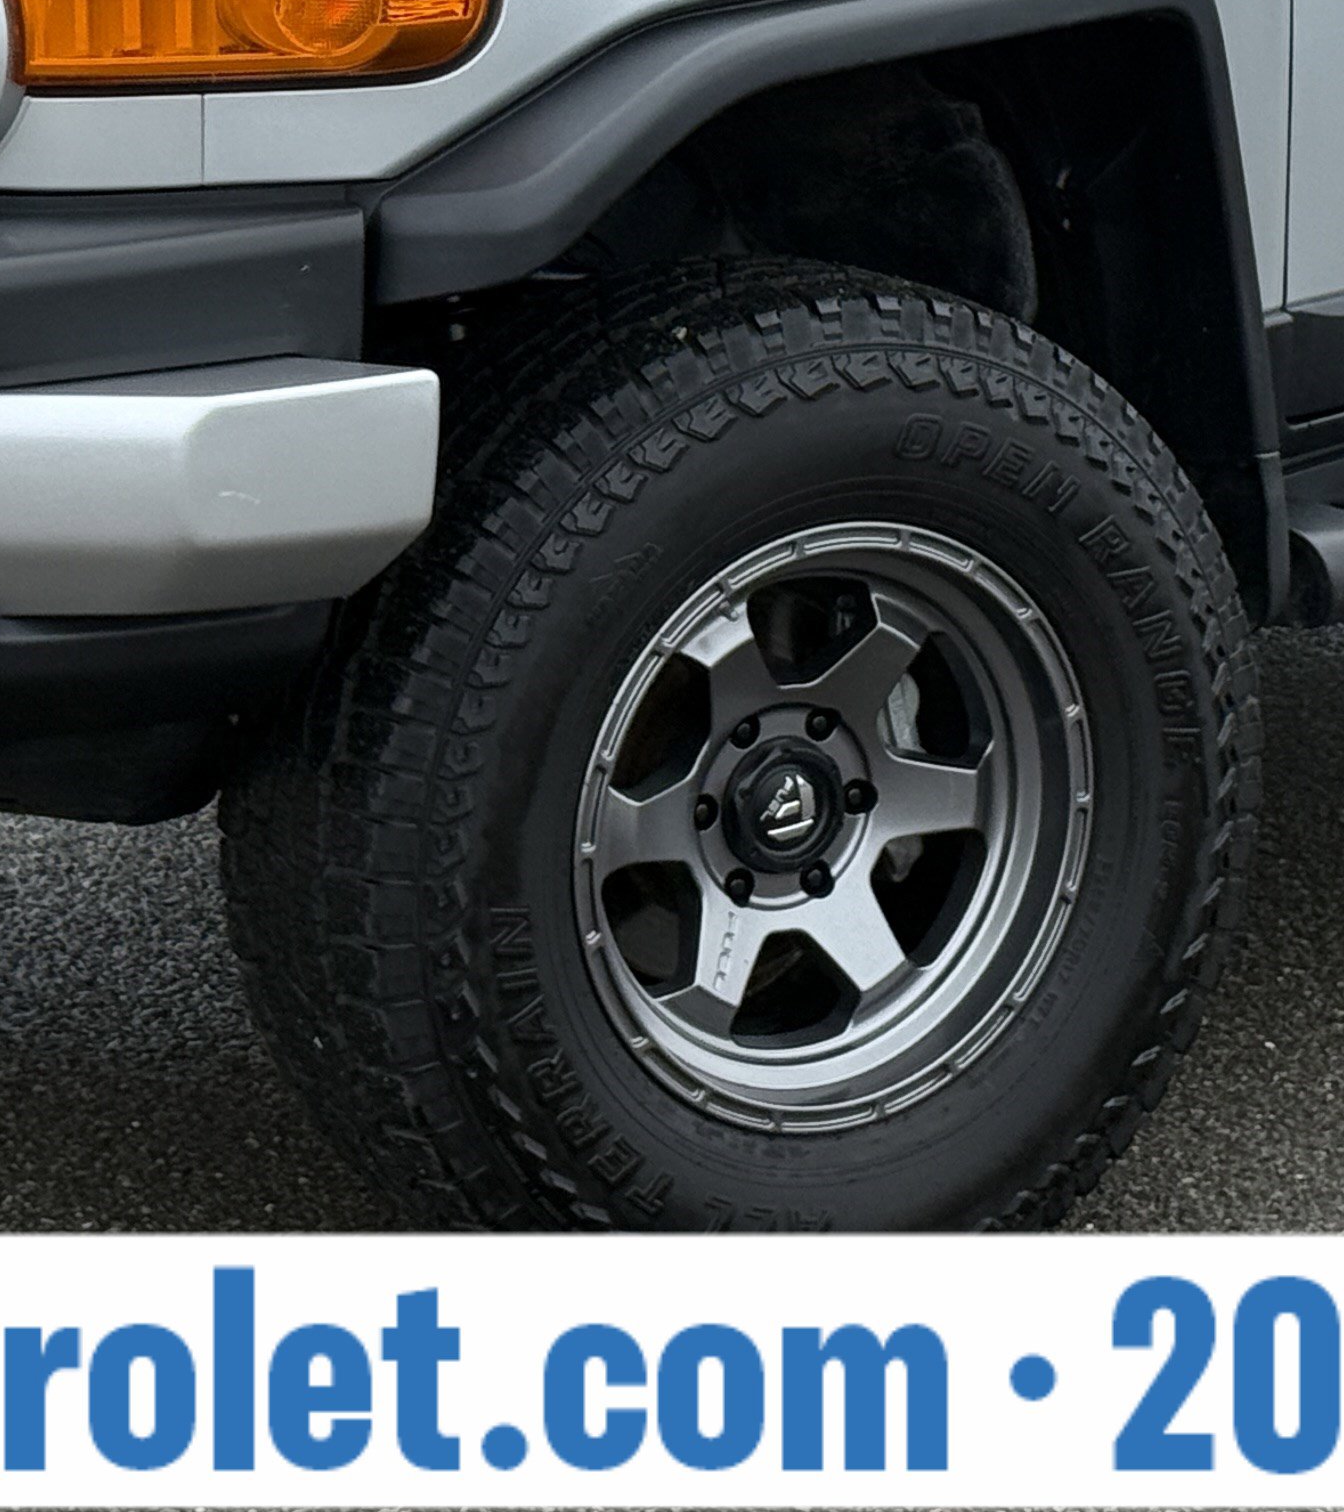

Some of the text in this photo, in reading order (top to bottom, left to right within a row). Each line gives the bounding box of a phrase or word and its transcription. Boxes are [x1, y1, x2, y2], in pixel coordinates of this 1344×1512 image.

[896, 412, 1082, 515] OPEN
[759, 775, 795, 822] FUEL
[488, 906, 676, 1218] TERRAIN
